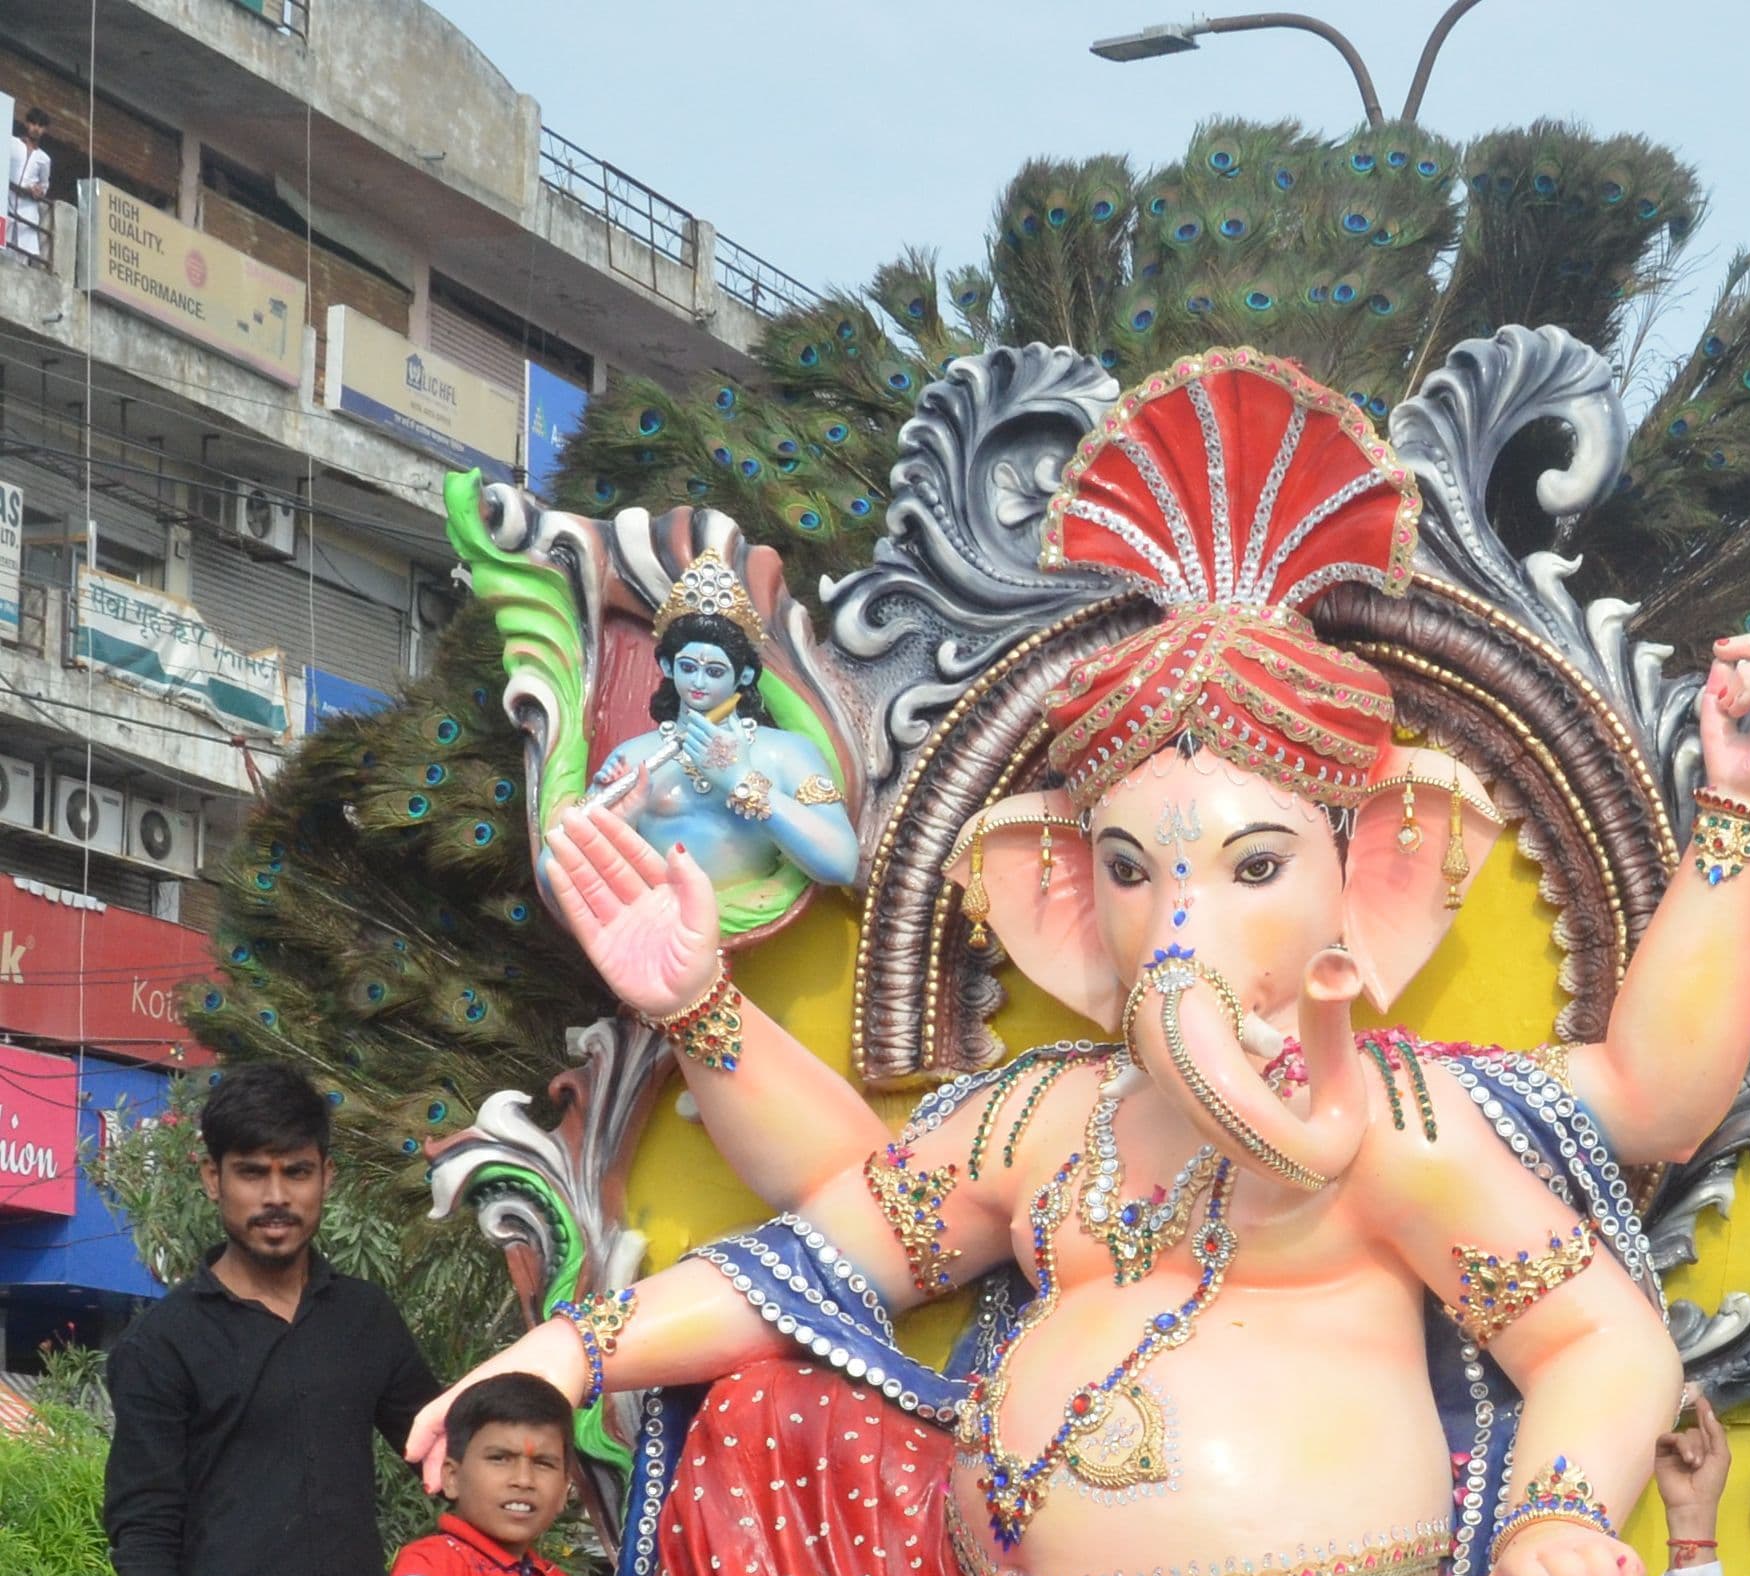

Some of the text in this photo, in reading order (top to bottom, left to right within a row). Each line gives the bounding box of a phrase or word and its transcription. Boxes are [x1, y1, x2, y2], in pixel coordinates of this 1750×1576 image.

[109, 194, 140, 223] HIGH
[108, 213, 165, 255] QUALITY.
[109, 240, 140, 268] HIGH
[109, 259, 206, 320] PERFORMANCE.
